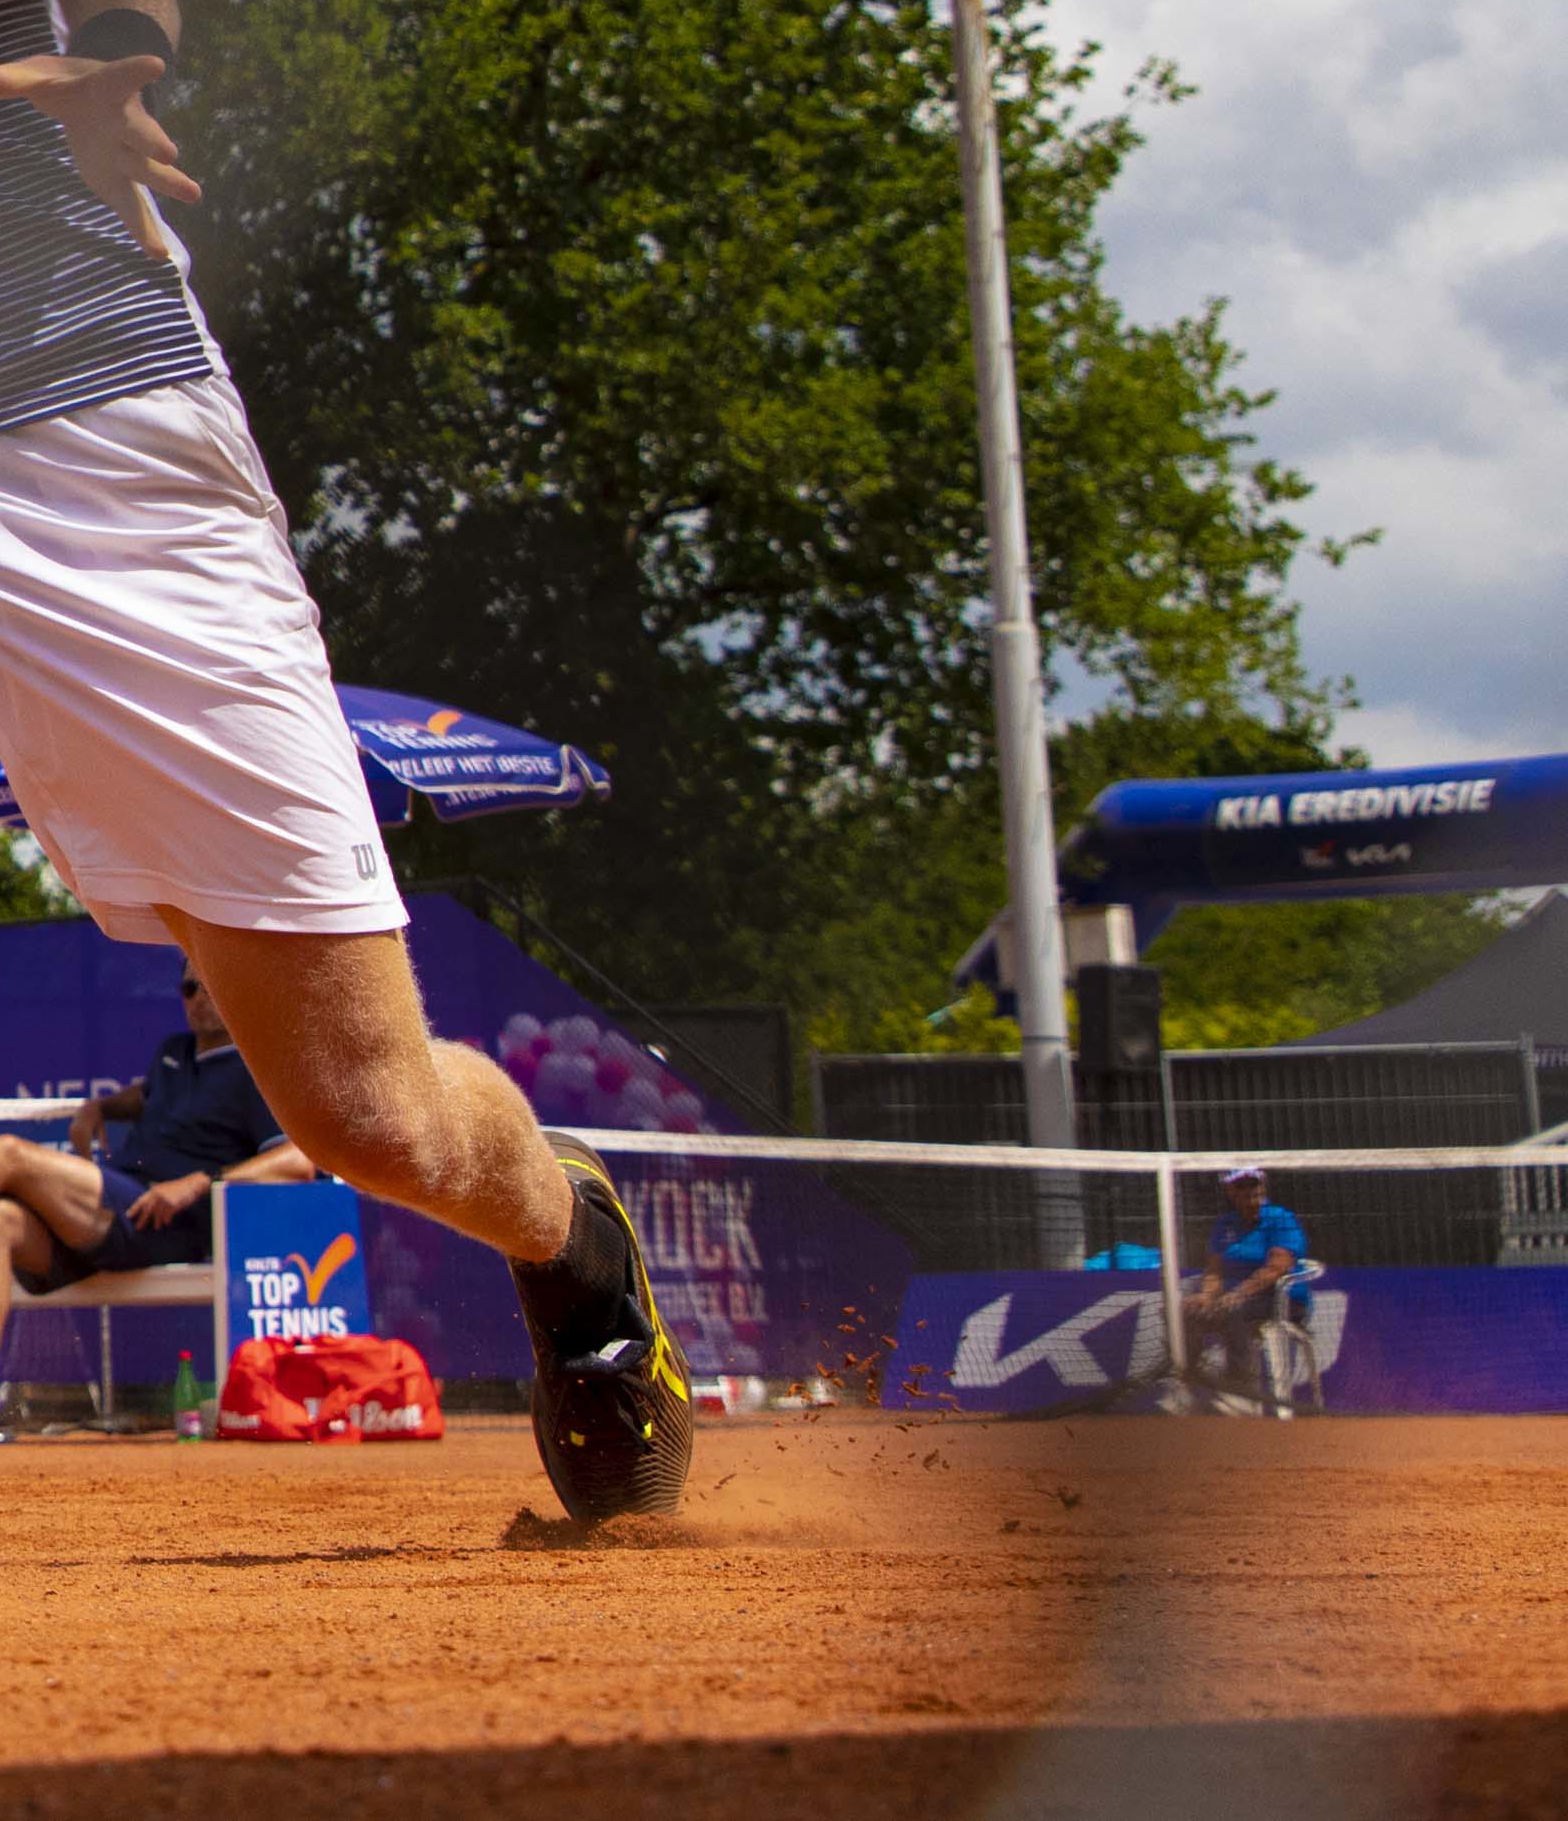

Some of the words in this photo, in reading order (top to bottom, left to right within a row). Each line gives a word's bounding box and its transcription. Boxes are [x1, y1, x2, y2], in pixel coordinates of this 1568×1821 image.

[1215, 794, 1282, 830] KIA
[1287, 778, 1497, 826] EREDIVISIE
[246, 1273, 300, 1307] TOP
[248, 1306, 349, 1342] TENNIS
